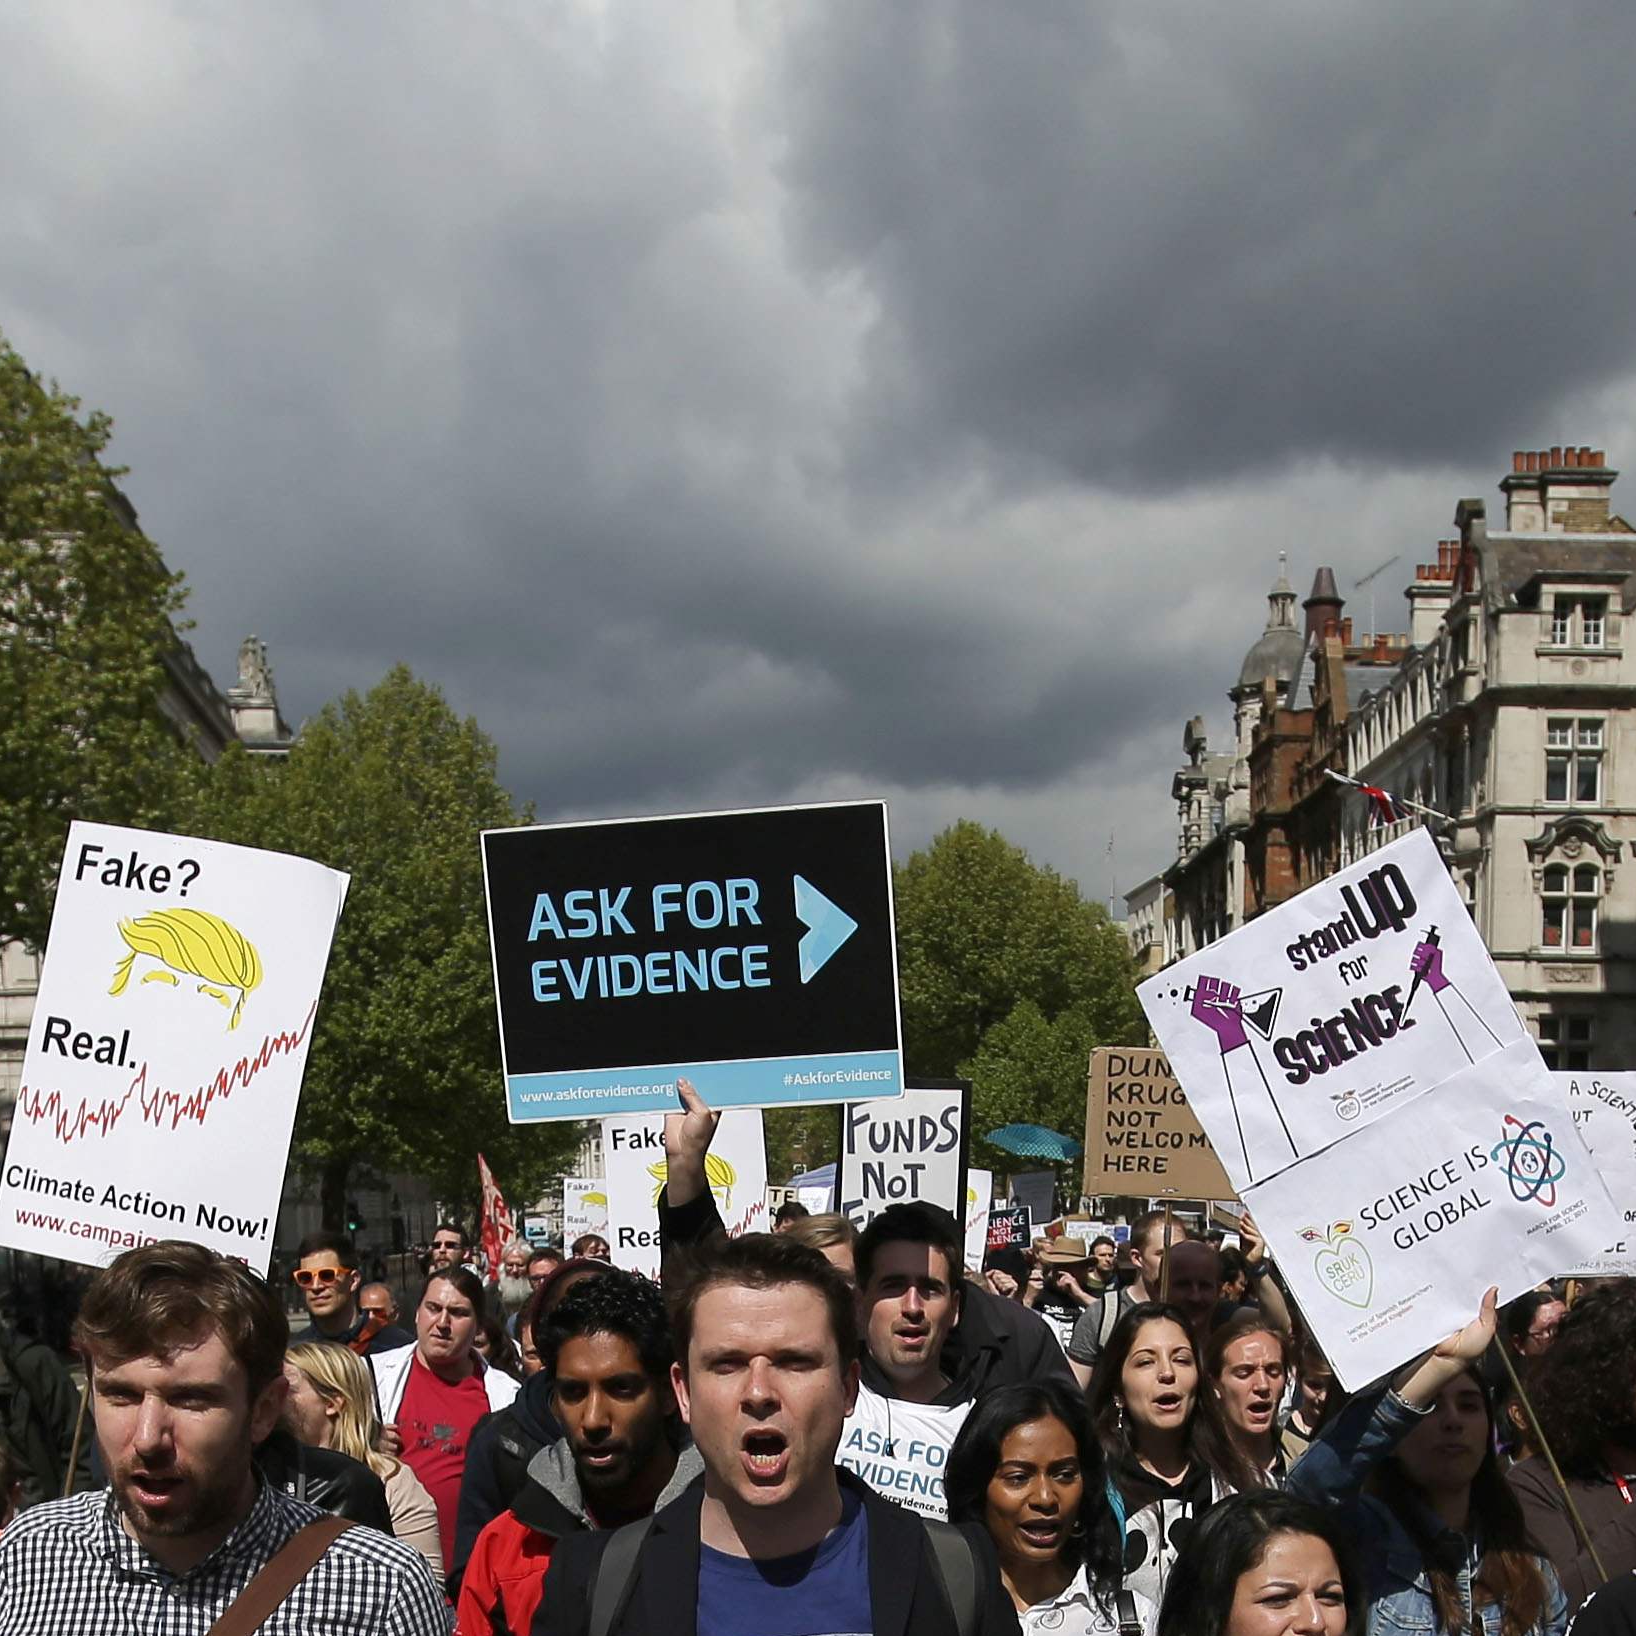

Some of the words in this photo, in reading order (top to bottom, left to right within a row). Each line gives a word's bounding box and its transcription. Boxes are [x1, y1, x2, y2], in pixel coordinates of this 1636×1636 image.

[74, 844, 202, 898] Fake?
[527, 886, 636, 942] ASK
[652, 877, 763, 932] FOR
[531, 945, 771, 1002] EVIDENCE
[1338, 955, 1369, 986] for
[41, 1015, 137, 1069] Real.
[782, 1067, 892, 1087] #AskforEvidence
[1569, 1080, 1580, 1096] A
[520, 1082, 674, 1104] www.askforevidence.org
[1107, 1082, 1187, 1106] KRUG
[846, 1104, 959, 1154] FUNDS
[1107, 1111, 1162, 1128] NOT
[612, 1126, 666, 1150] Fake
[1106, 1131, 1215, 1149] WELCOM
[1103, 1153, 1168, 1173] HERE
[1360, 1160, 1462, 1230] SCIENCE
[1463, 1145, 1488, 1172] IS
[5, 1164, 96, 1205] Climate
[100, 1184, 186, 1224] Action
[195, 1204, 269, 1241] Now!
[992, 1227, 1012, 1236] NOT
[1393, 1188, 1491, 1249] GLOBAL
[618, 1226, 662, 1248] Rea
[1326, 1253, 1359, 1280] SRUK
[845, 1428, 902, 1461] ASK
[908, 1440, 946, 1467] FO
